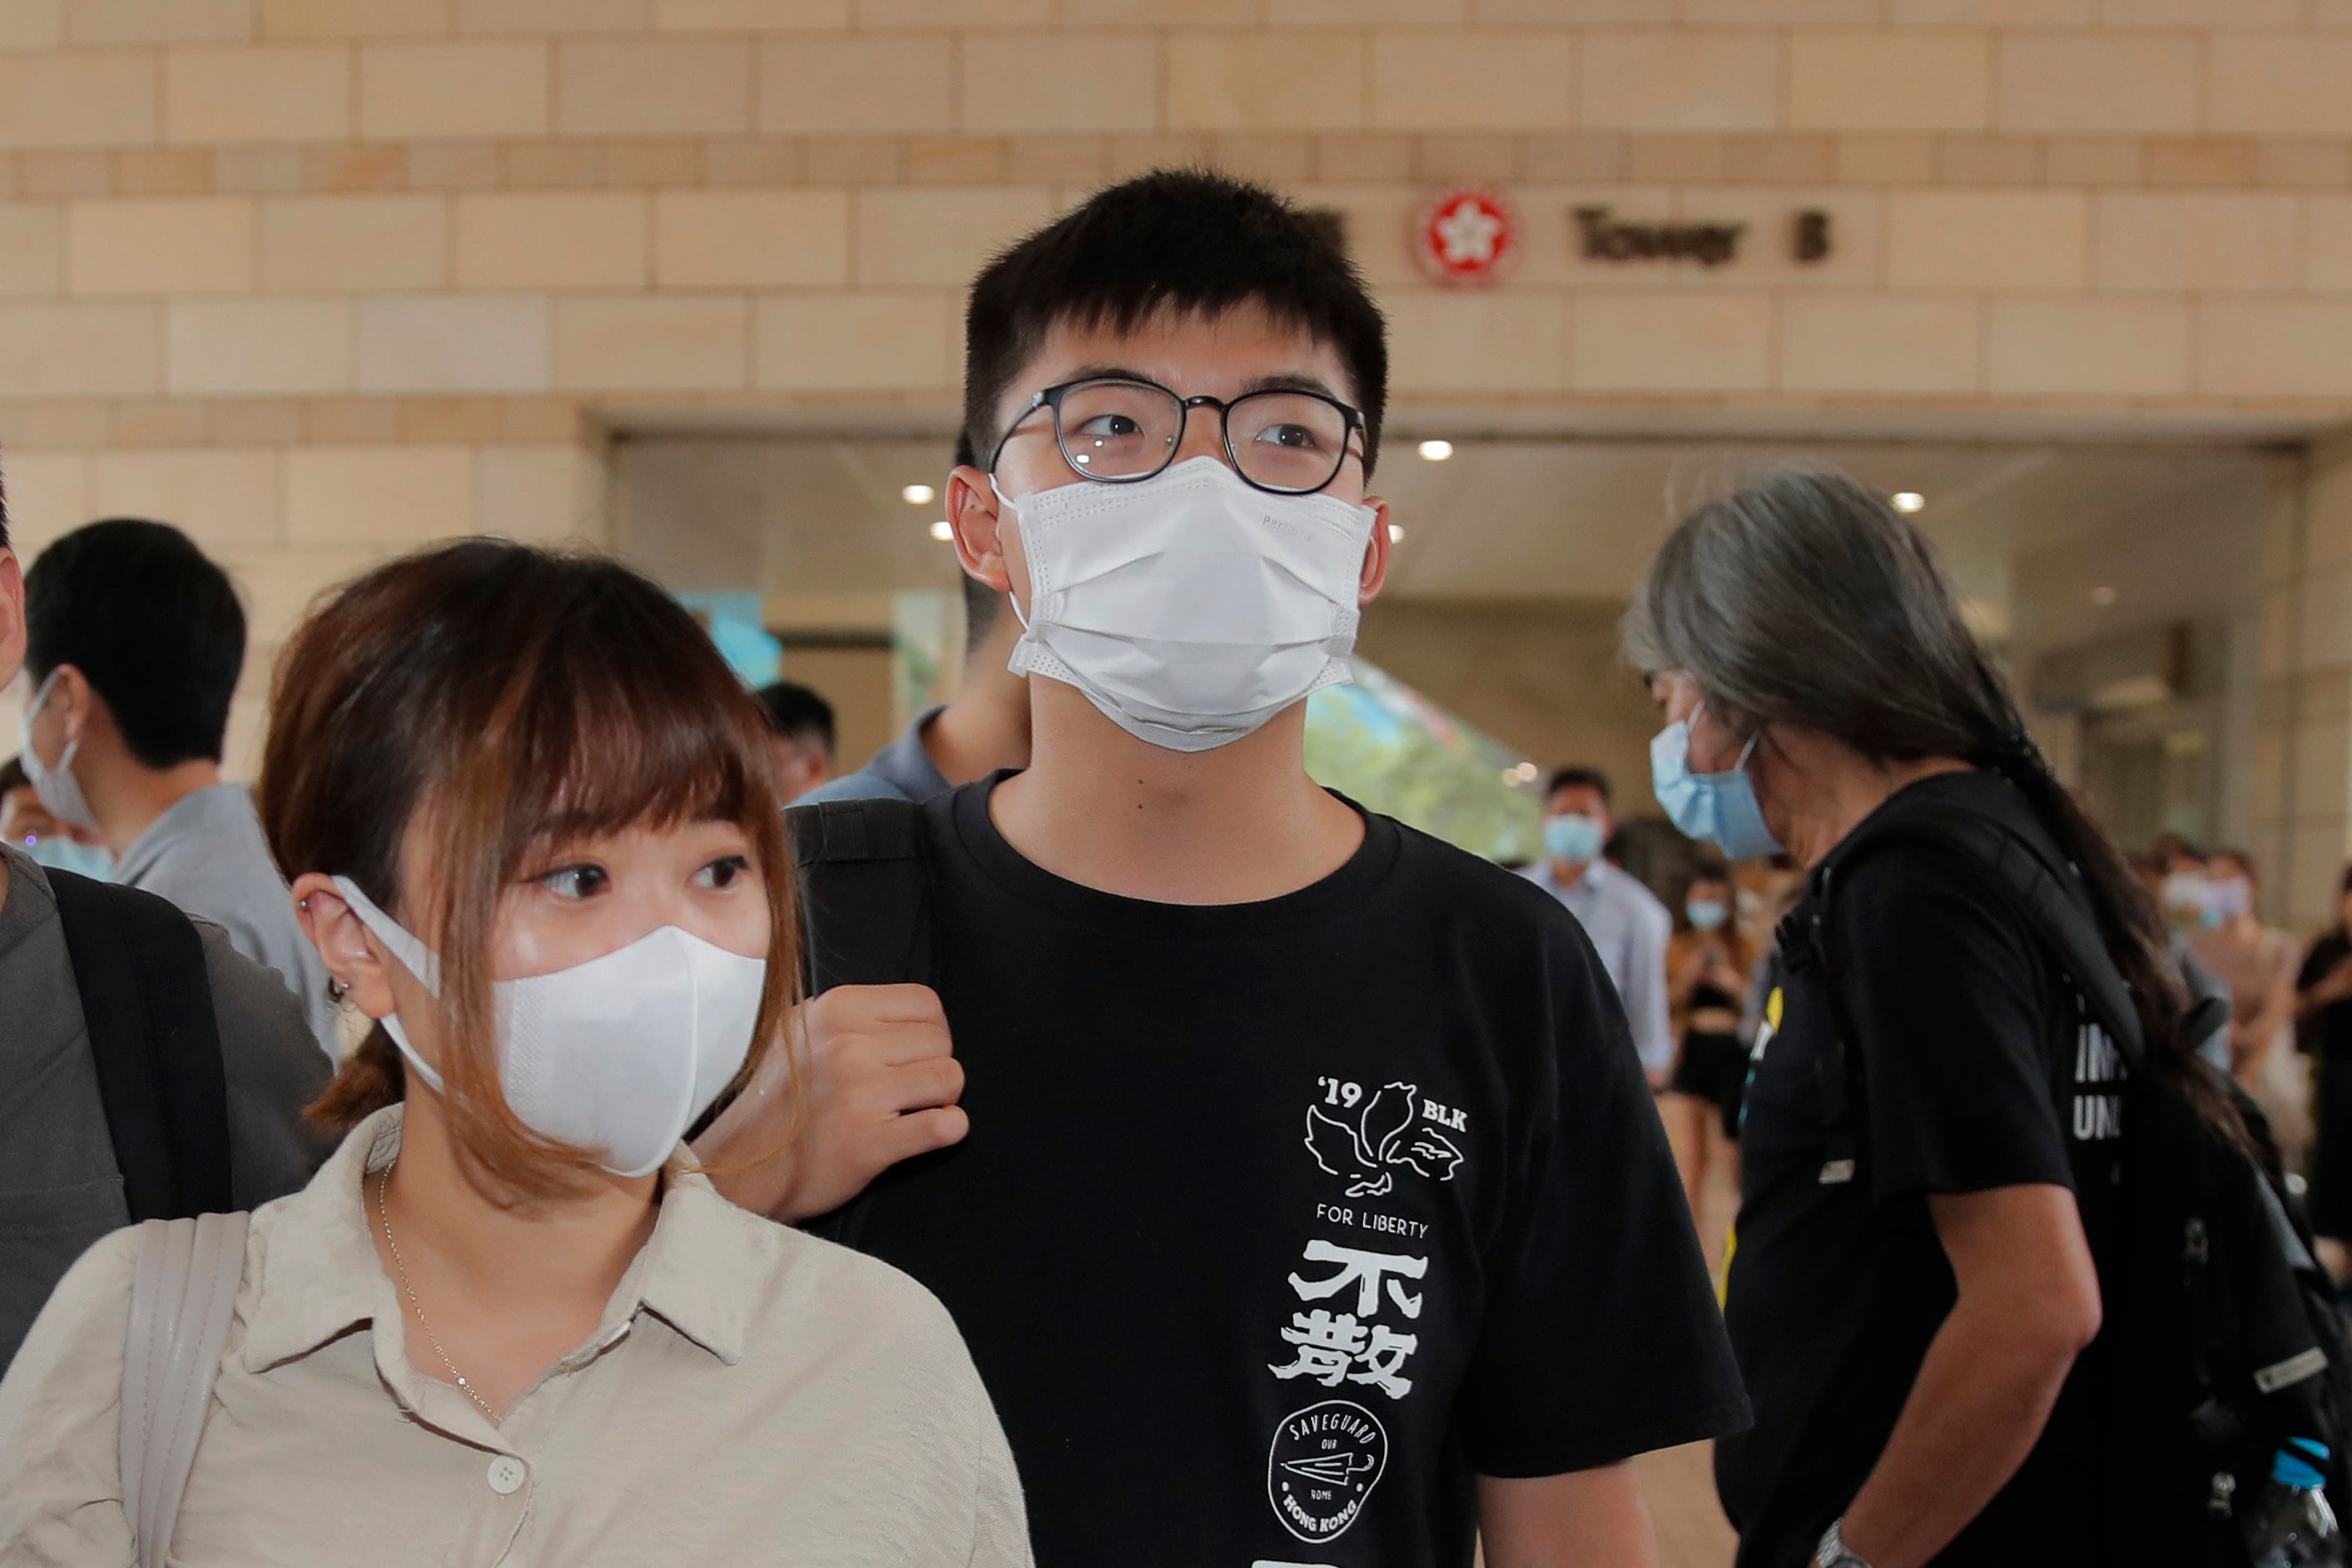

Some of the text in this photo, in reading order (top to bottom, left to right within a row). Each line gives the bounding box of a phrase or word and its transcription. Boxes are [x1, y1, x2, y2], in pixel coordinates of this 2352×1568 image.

[1570, 205, 1748, 270] Tower
[1422, 1099, 1468, 1133] BLK
[1317, 1203, 1428, 1239] FOR LIBERTY
[1288, 1413, 1377, 1444] SAVEGUARD
[1283, 1493, 1357, 1532] HONG KONG
[1310, 1489, 1332, 1501] HOME
